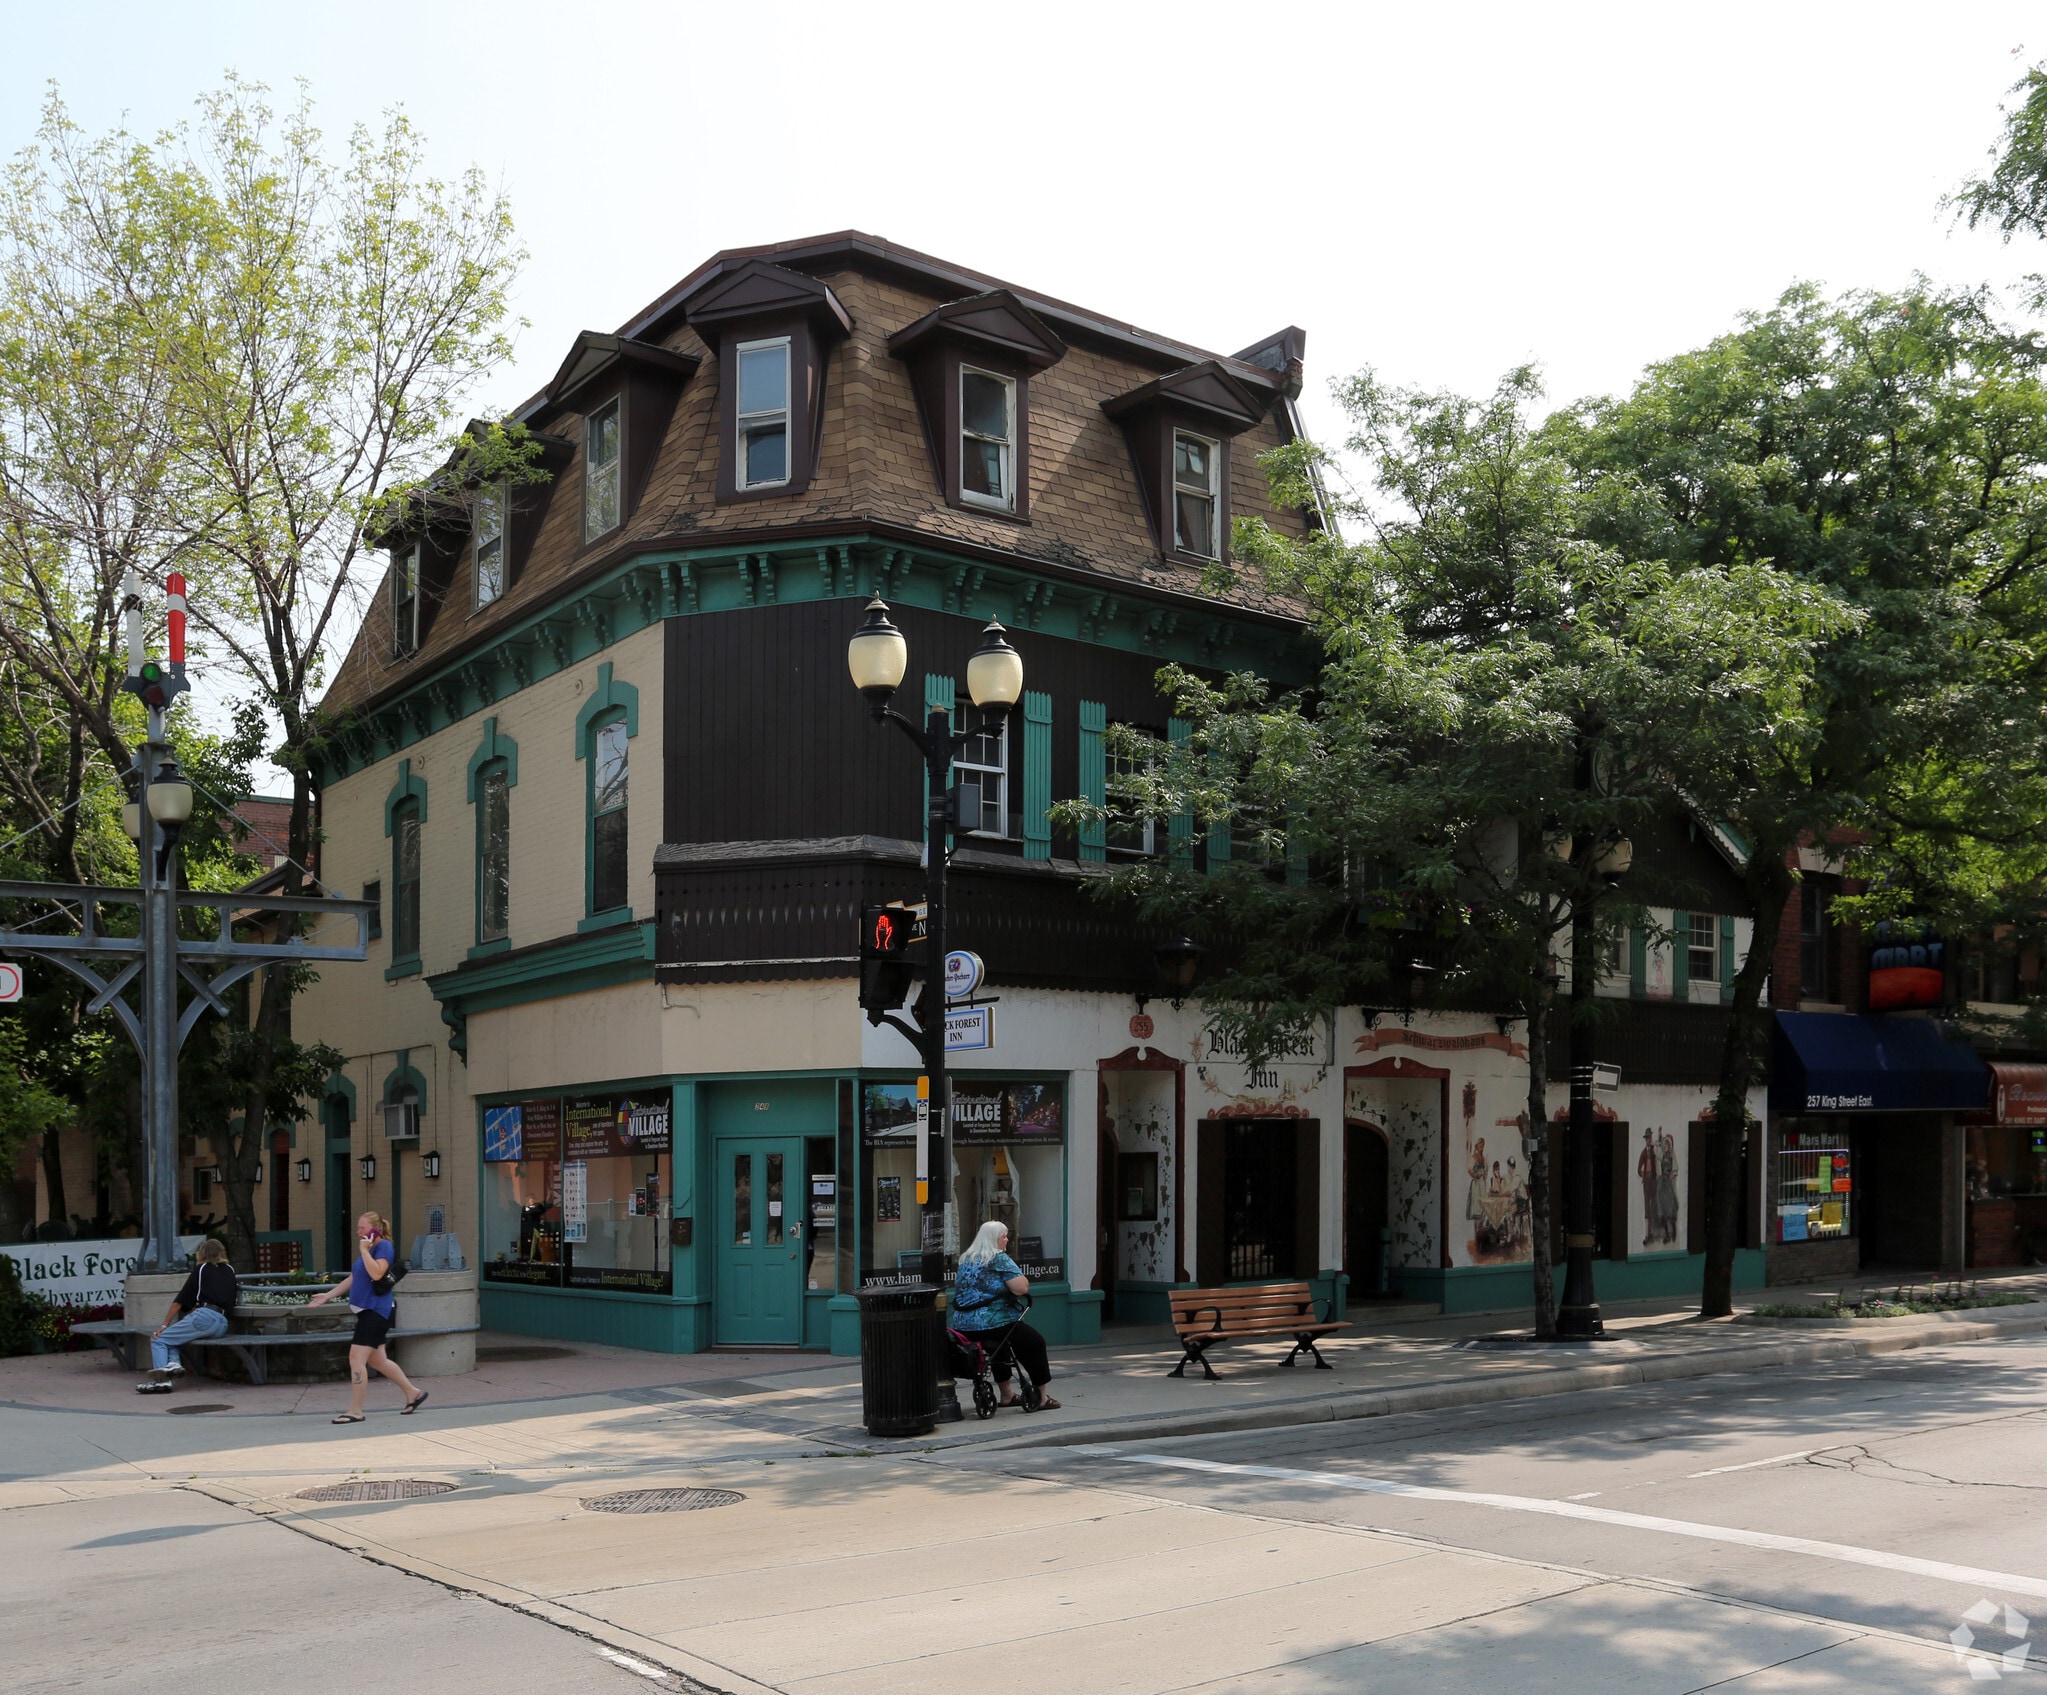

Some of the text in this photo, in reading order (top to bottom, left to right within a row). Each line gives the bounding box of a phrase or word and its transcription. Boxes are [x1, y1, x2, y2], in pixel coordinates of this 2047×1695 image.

[1872, 943, 1944, 969] MART
[955, 1017, 981, 1030] FOREST
[1134, 1021, 1149, 1032] 255
[949, 1033, 963, 1042] INN
[1402, 1030, 1487, 1049] Schwarzwaldhaus
[1244, 1067, 1280, 1090] Inn
[565, 1101, 612, 1120] International
[1807, 1095, 1874, 1109] 257 King Street East.
[951, 1104, 1002, 1122] ILLAGE
[565, 1122, 593, 1142] Village,
[628, 1114, 669, 1136] VILLAGE
[883, 1139, 905, 1148] represents
[1799, 1133, 1819, 1146] Mars
[1820, 1132, 1840, 1145] Mart
[11, 1252, 138, 1281] Black Fore
[601, 1271, 639, 1286] International
[639, 1273, 664, 1291] Village!
